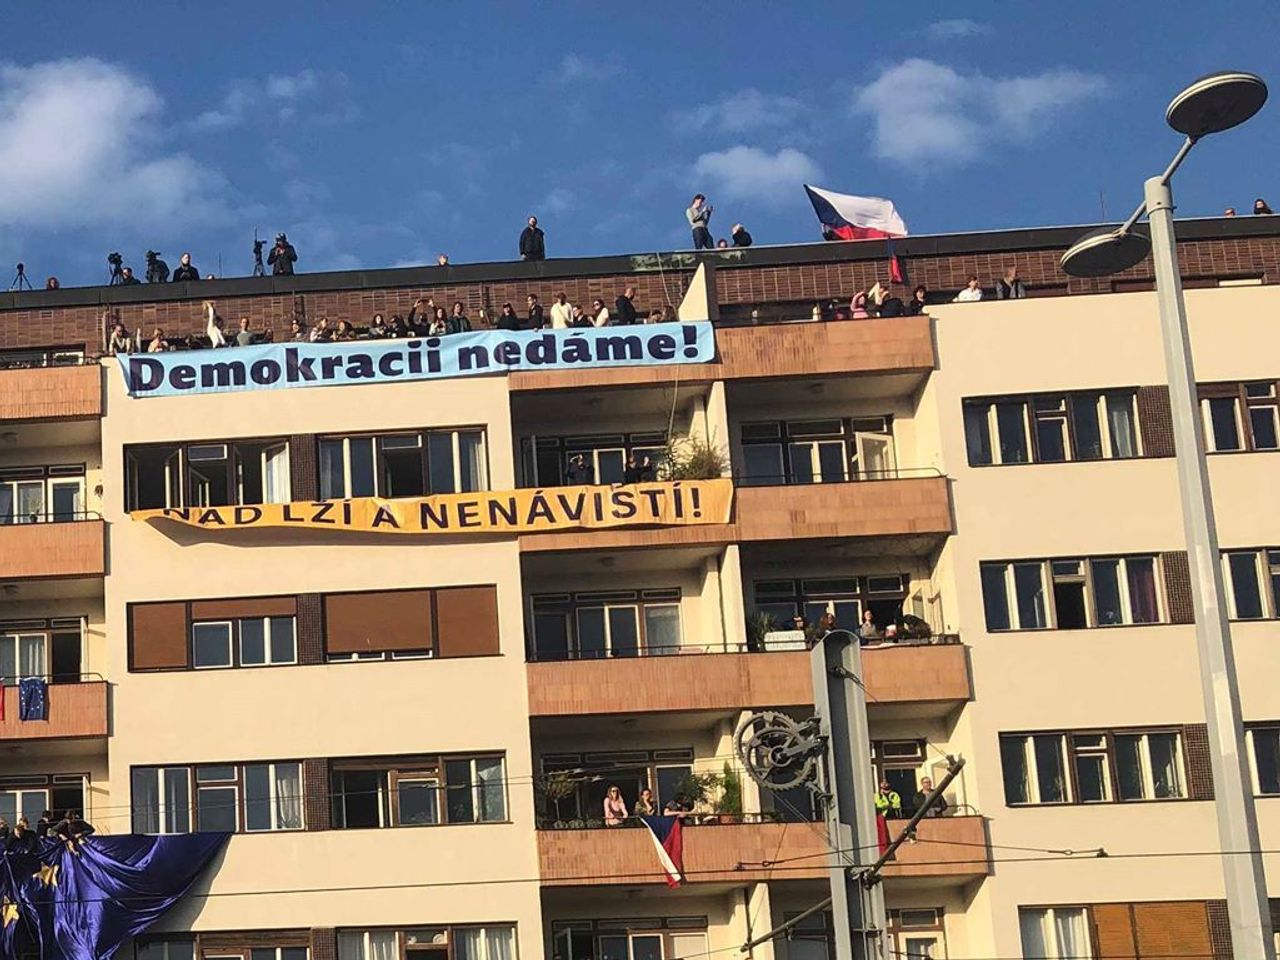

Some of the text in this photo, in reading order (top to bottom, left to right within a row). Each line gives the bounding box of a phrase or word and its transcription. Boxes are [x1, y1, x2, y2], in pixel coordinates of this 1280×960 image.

[128, 324, 698, 392] Demokracii nedáme!
[372, 504, 400, 529] A
[420, 482, 702, 530] NENÁVISTÍ!
